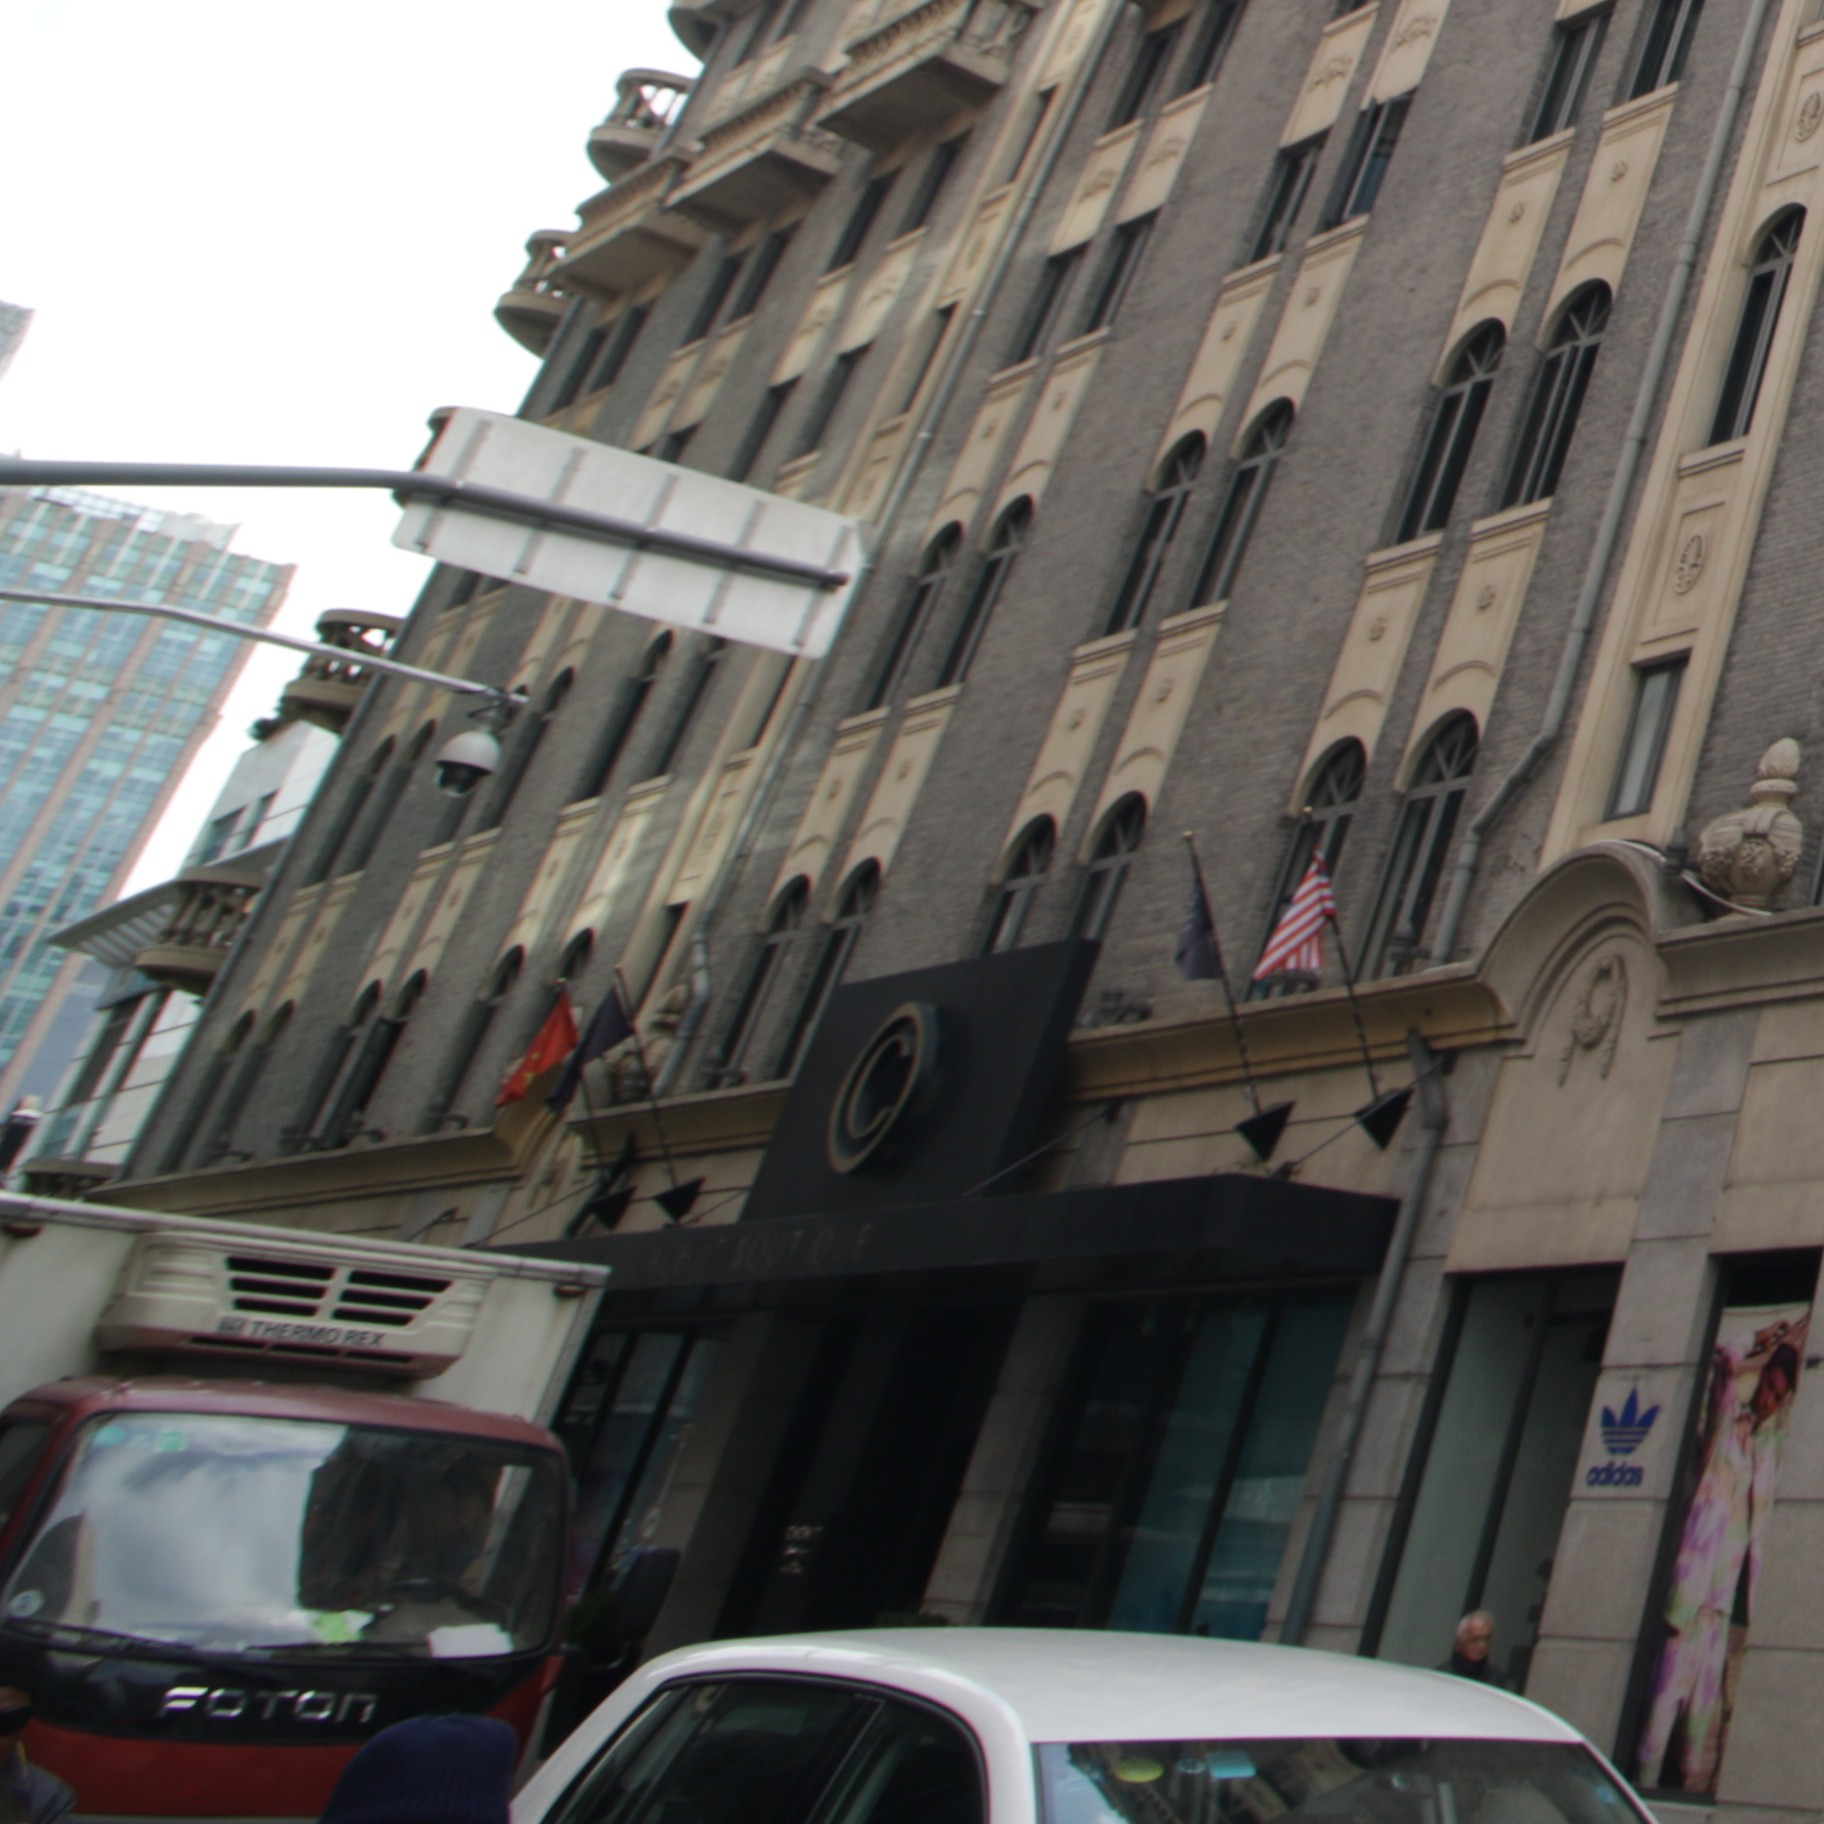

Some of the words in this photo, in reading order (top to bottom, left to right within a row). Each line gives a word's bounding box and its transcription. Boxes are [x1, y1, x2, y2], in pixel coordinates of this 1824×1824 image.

[249, 1320, 340, 1344] THERMO
[341, 1329, 386, 1348] REX
[1586, 1460, 1644, 1487] adidas
[155, 1685, 379, 1724] FOTON
